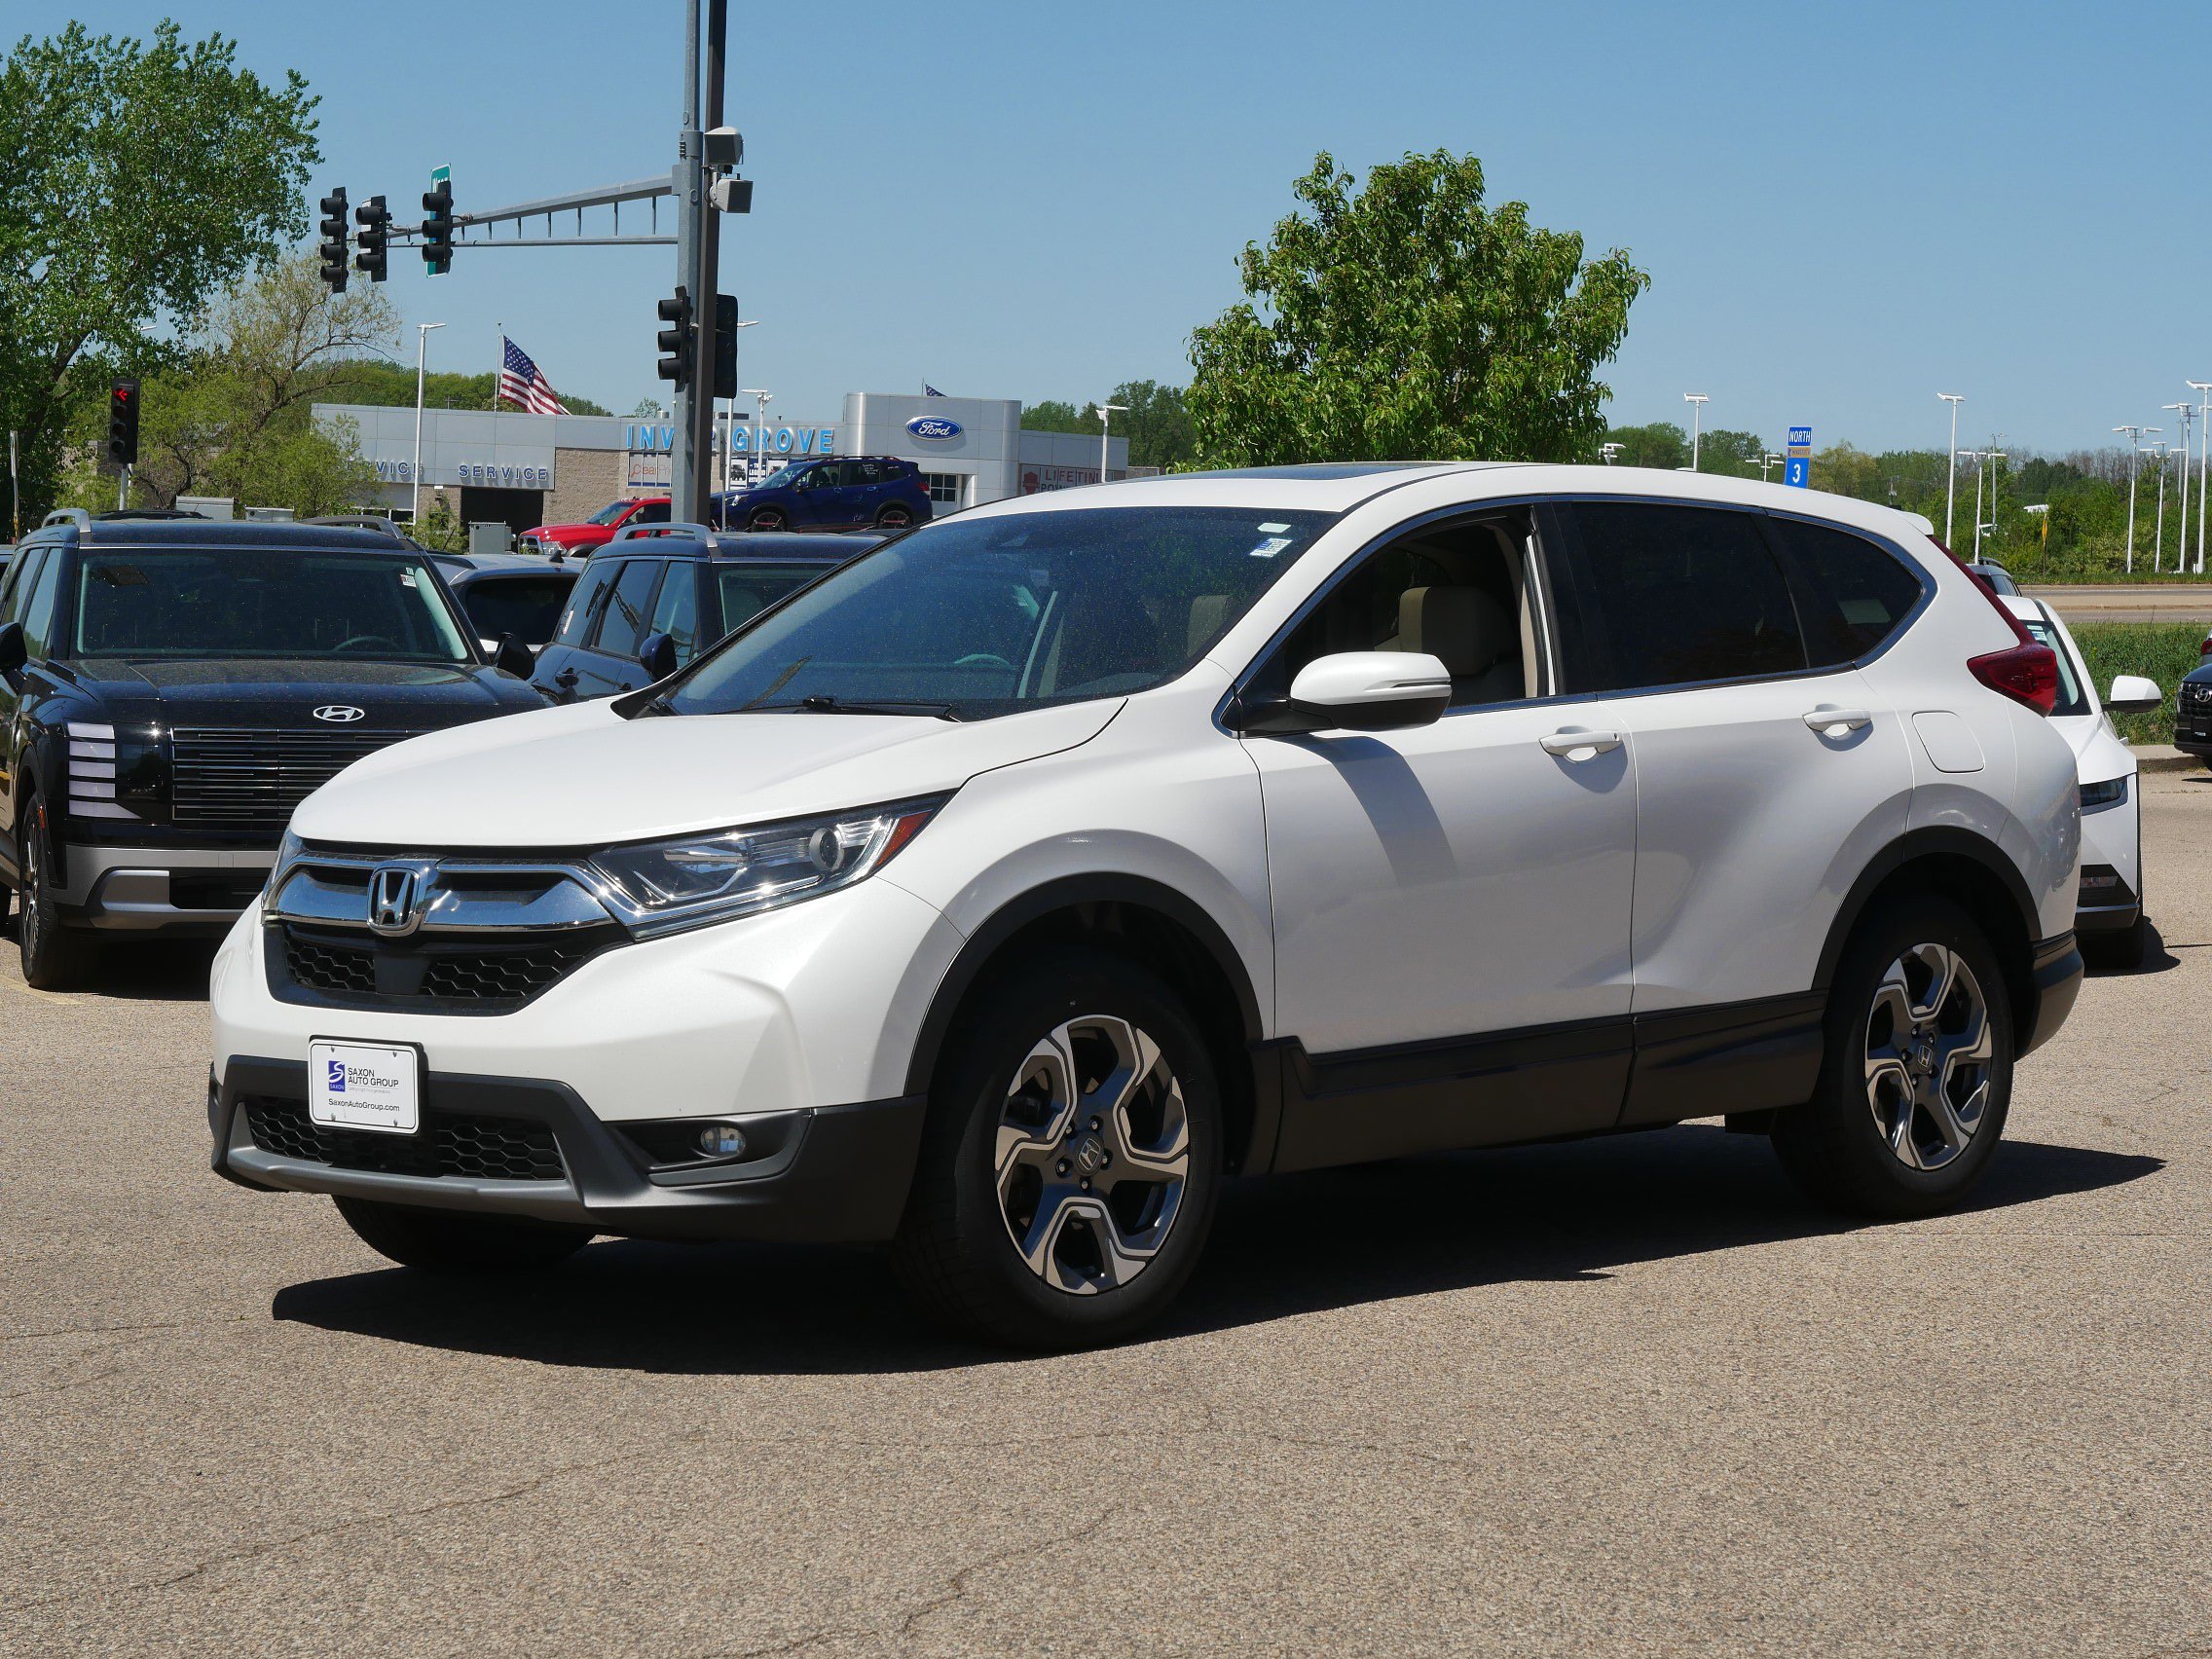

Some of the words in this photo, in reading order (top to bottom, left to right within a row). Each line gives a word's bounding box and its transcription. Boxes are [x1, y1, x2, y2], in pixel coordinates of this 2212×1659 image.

[918, 421, 951, 436] Ford
[626, 424, 675, 450] INV
[732, 426, 833, 454] GROVE
[1789, 430, 1811, 442] NORTH
[459, 464, 547, 480] SERVICE
[1792, 463, 1801, 483] 3
[348, 1067, 375, 1077] SAXON
[348, 1076, 369, 1086] AUTO
[370, 1078, 399, 1088] GROUP
[328, 1098, 400, 1112] SaxonAutoGroup.com
